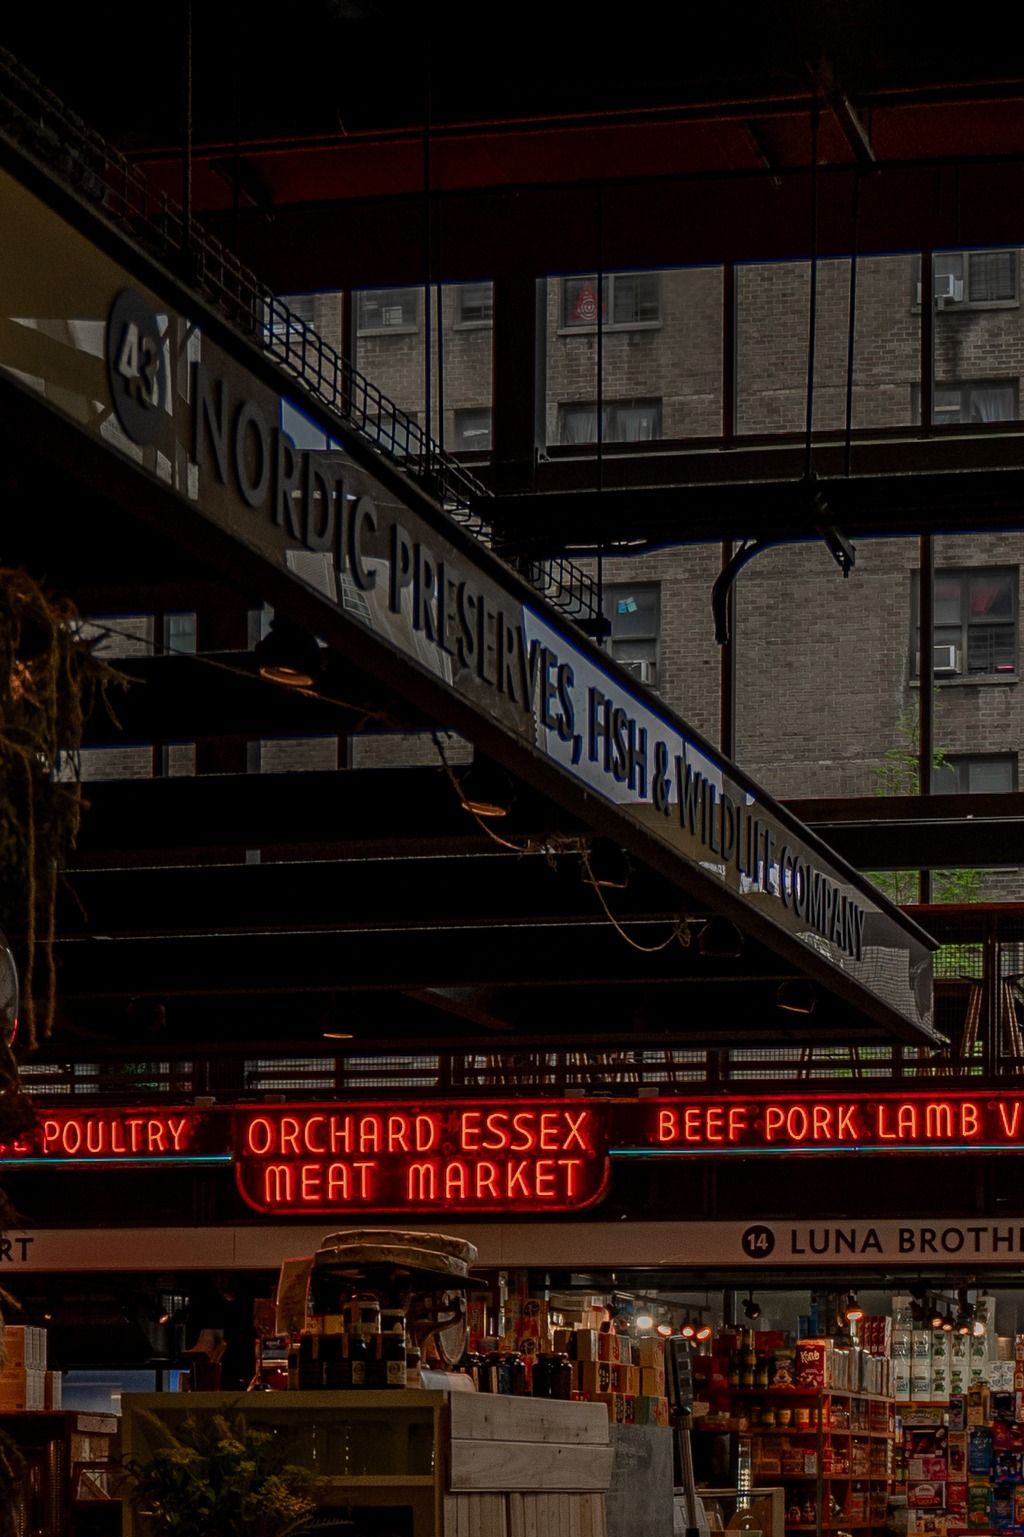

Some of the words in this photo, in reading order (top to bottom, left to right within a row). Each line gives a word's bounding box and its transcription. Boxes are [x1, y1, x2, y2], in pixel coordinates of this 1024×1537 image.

[116, 321, 160, 409] 43
[191, 360, 377, 591] NORDIC
[389, 523, 583, 765] PRESERVES,
[588, 686, 648, 798] FISH
[651, 741, 672, 816] &
[675, 755, 778, 897] WILDLIFE
[781, 846, 865, 961] COMPANY
[43, 1118, 187, 1154] POULTRY
[248, 1115, 436, 1155] ORCHARD
[460, 1111, 589, 1151] ESSEX
[657, 1107, 746, 1142] BEEF
[765, 1104, 857, 1141] PORK
[877, 1103, 979, 1139] LAMB
[264, 1161, 376, 1202] MEAT
[407, 1159, 580, 1200] MARKET
[747, 1232, 769, 1251] 14
[791, 1228, 883, 1254] LUNA
